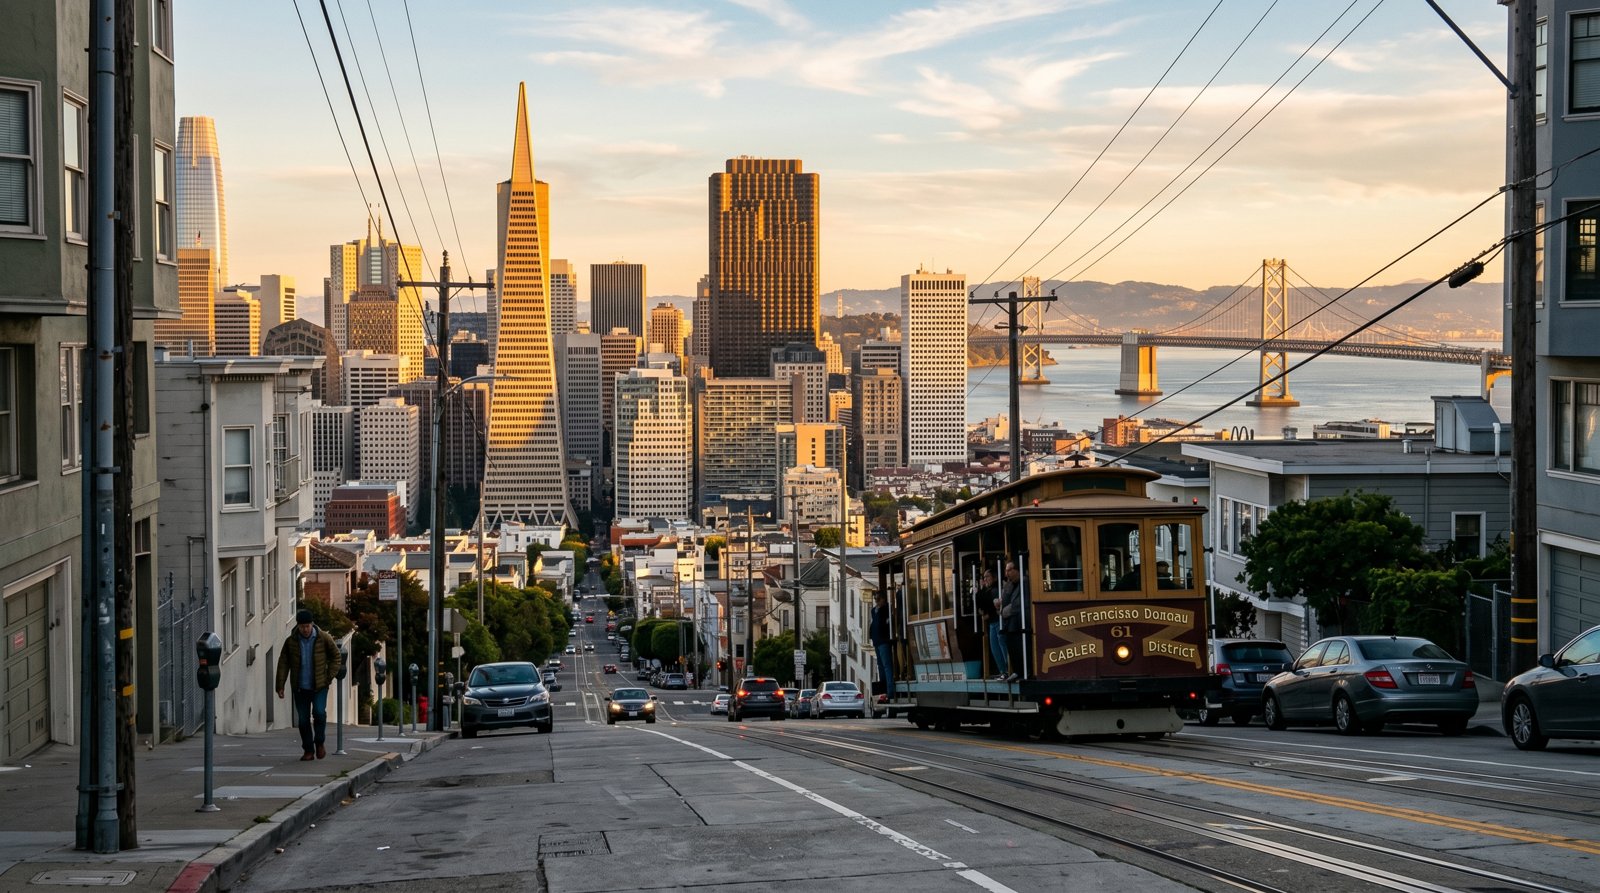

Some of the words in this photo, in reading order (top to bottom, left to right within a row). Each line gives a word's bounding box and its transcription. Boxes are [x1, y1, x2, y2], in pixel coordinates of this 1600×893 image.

[1053, 614, 1076, 627] San
[1110, 625, 1133, 638] 61
[1049, 643, 1097, 663] CABLER
